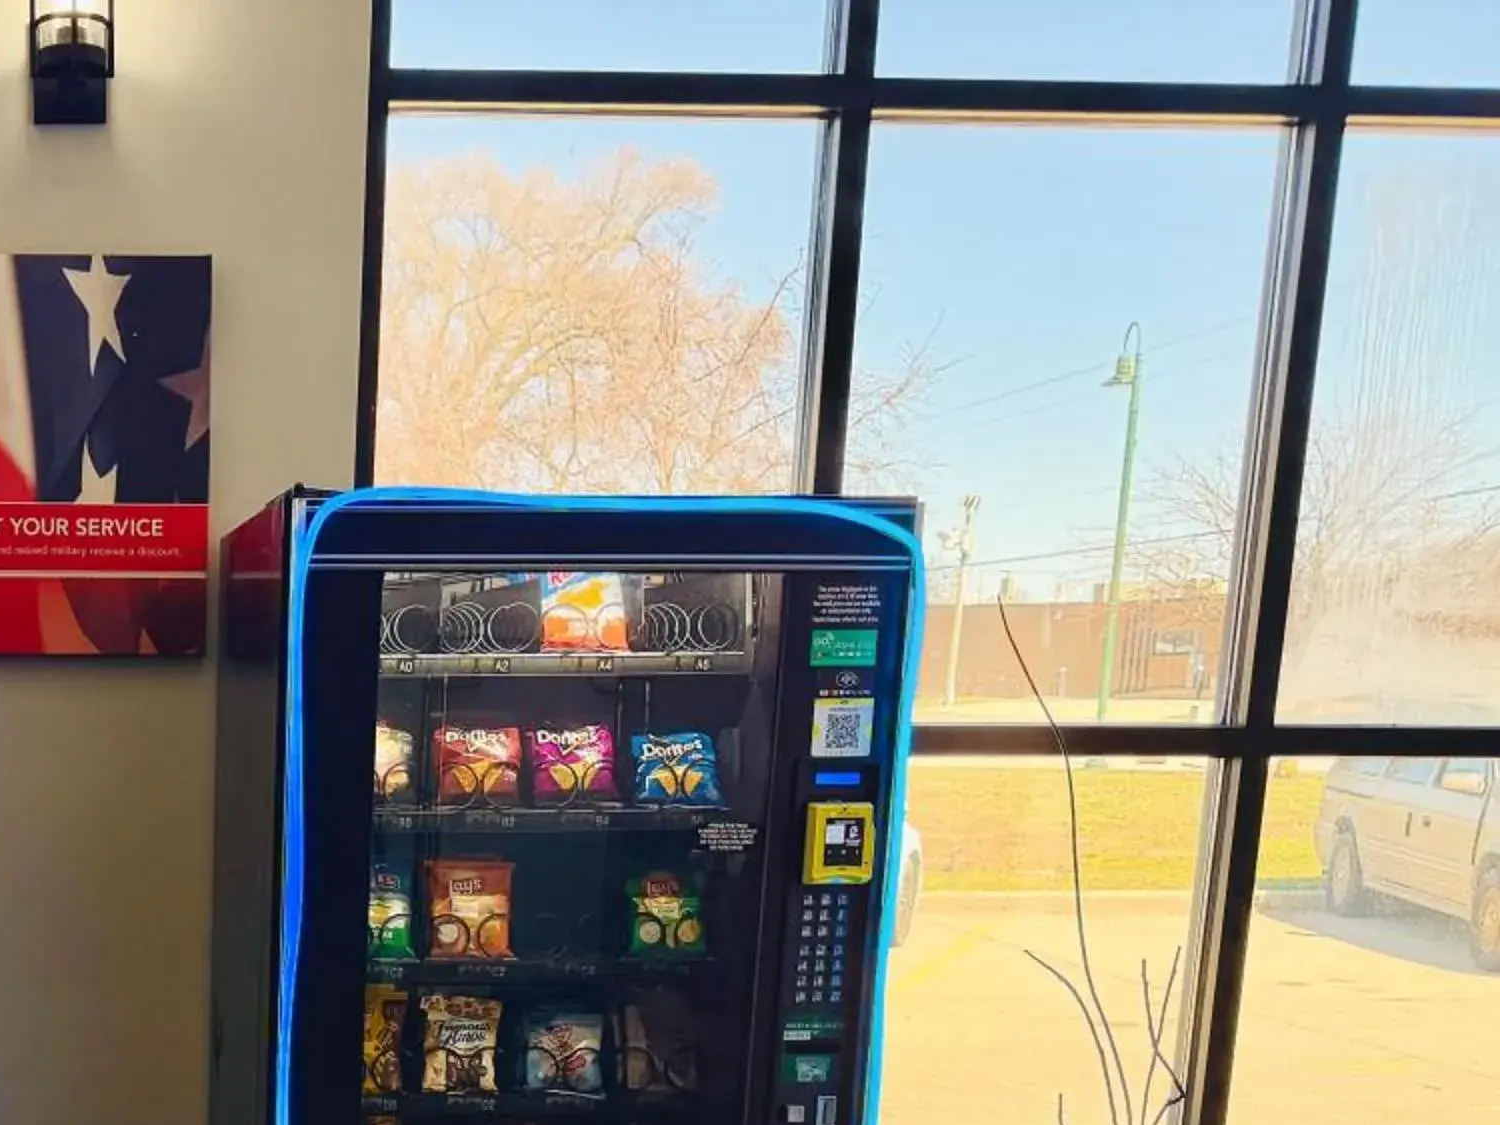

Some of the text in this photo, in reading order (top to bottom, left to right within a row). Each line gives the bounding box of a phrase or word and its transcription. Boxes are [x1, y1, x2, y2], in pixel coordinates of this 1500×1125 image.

[9, 517, 69, 536] YOUR
[75, 518, 164, 537] SERVICE
[641, 739, 703, 764] Doritos
